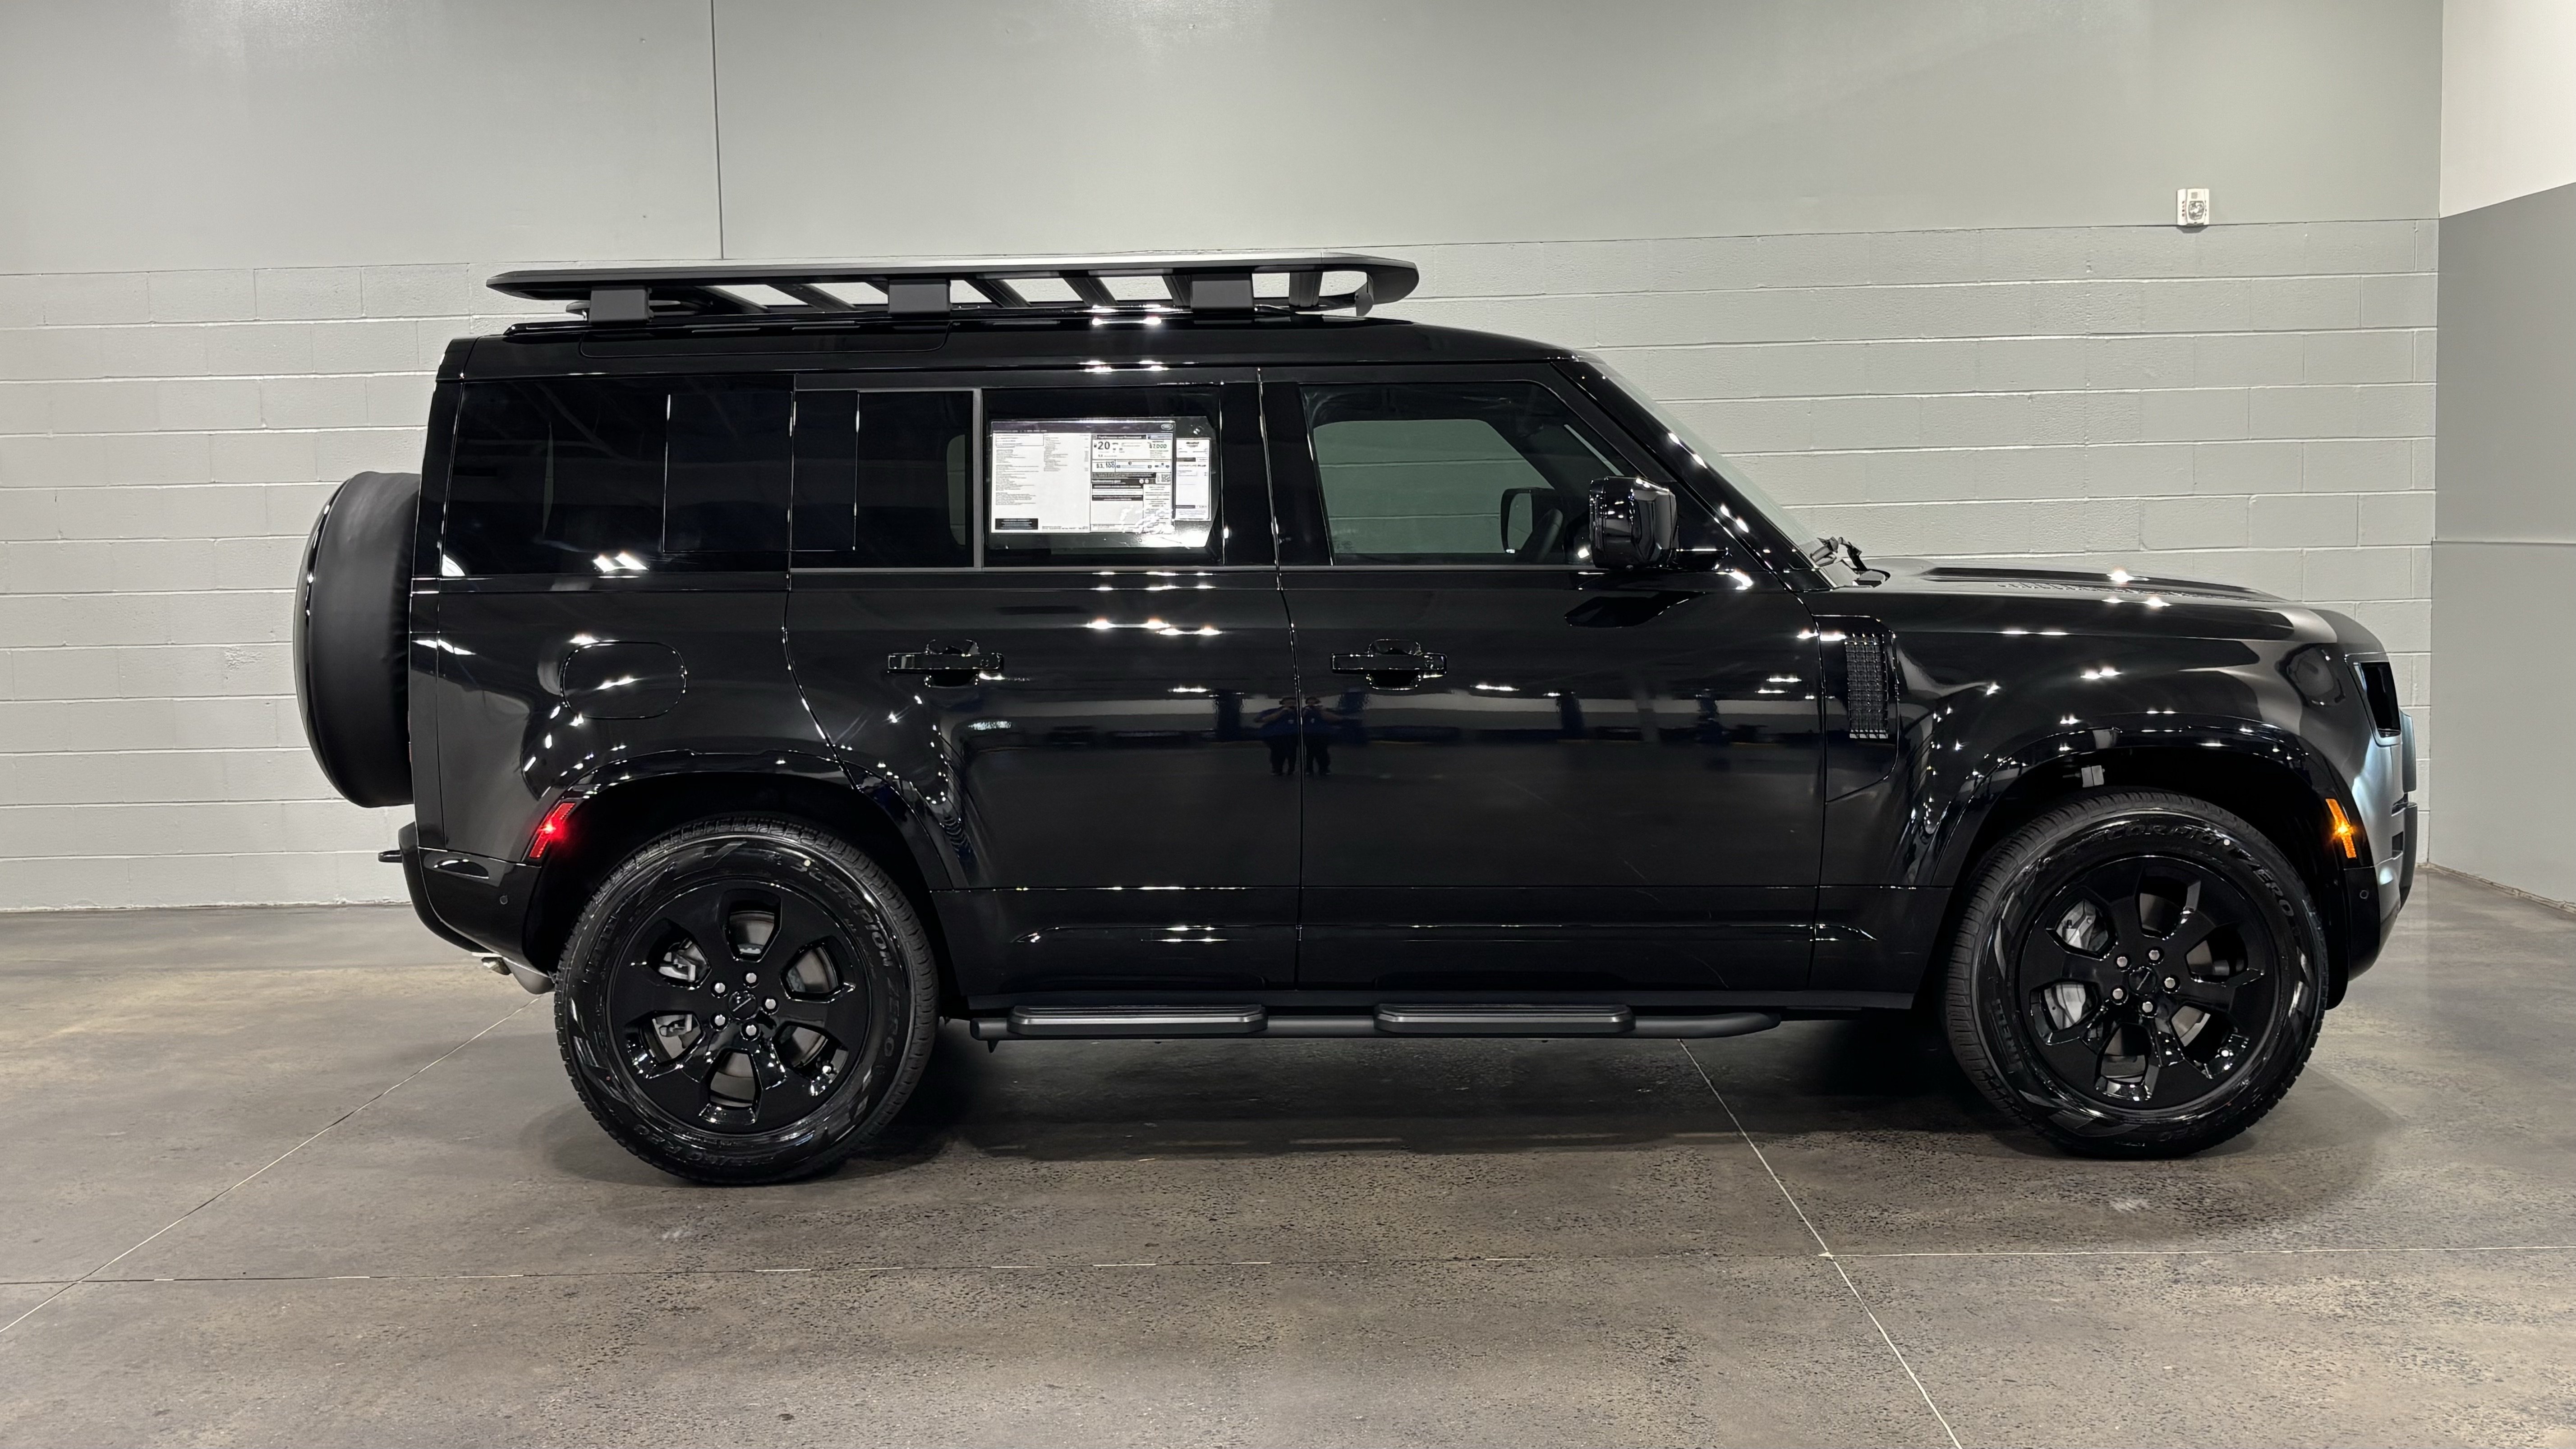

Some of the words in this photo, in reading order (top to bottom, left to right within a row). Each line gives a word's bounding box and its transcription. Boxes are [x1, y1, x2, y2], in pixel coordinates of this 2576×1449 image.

[1097, 441, 1110, 450] 20
[2237, 851, 2295, 917] ZERO
[790, 860, 894, 967] SCORPION
[884, 977, 900, 1058] ZERO
